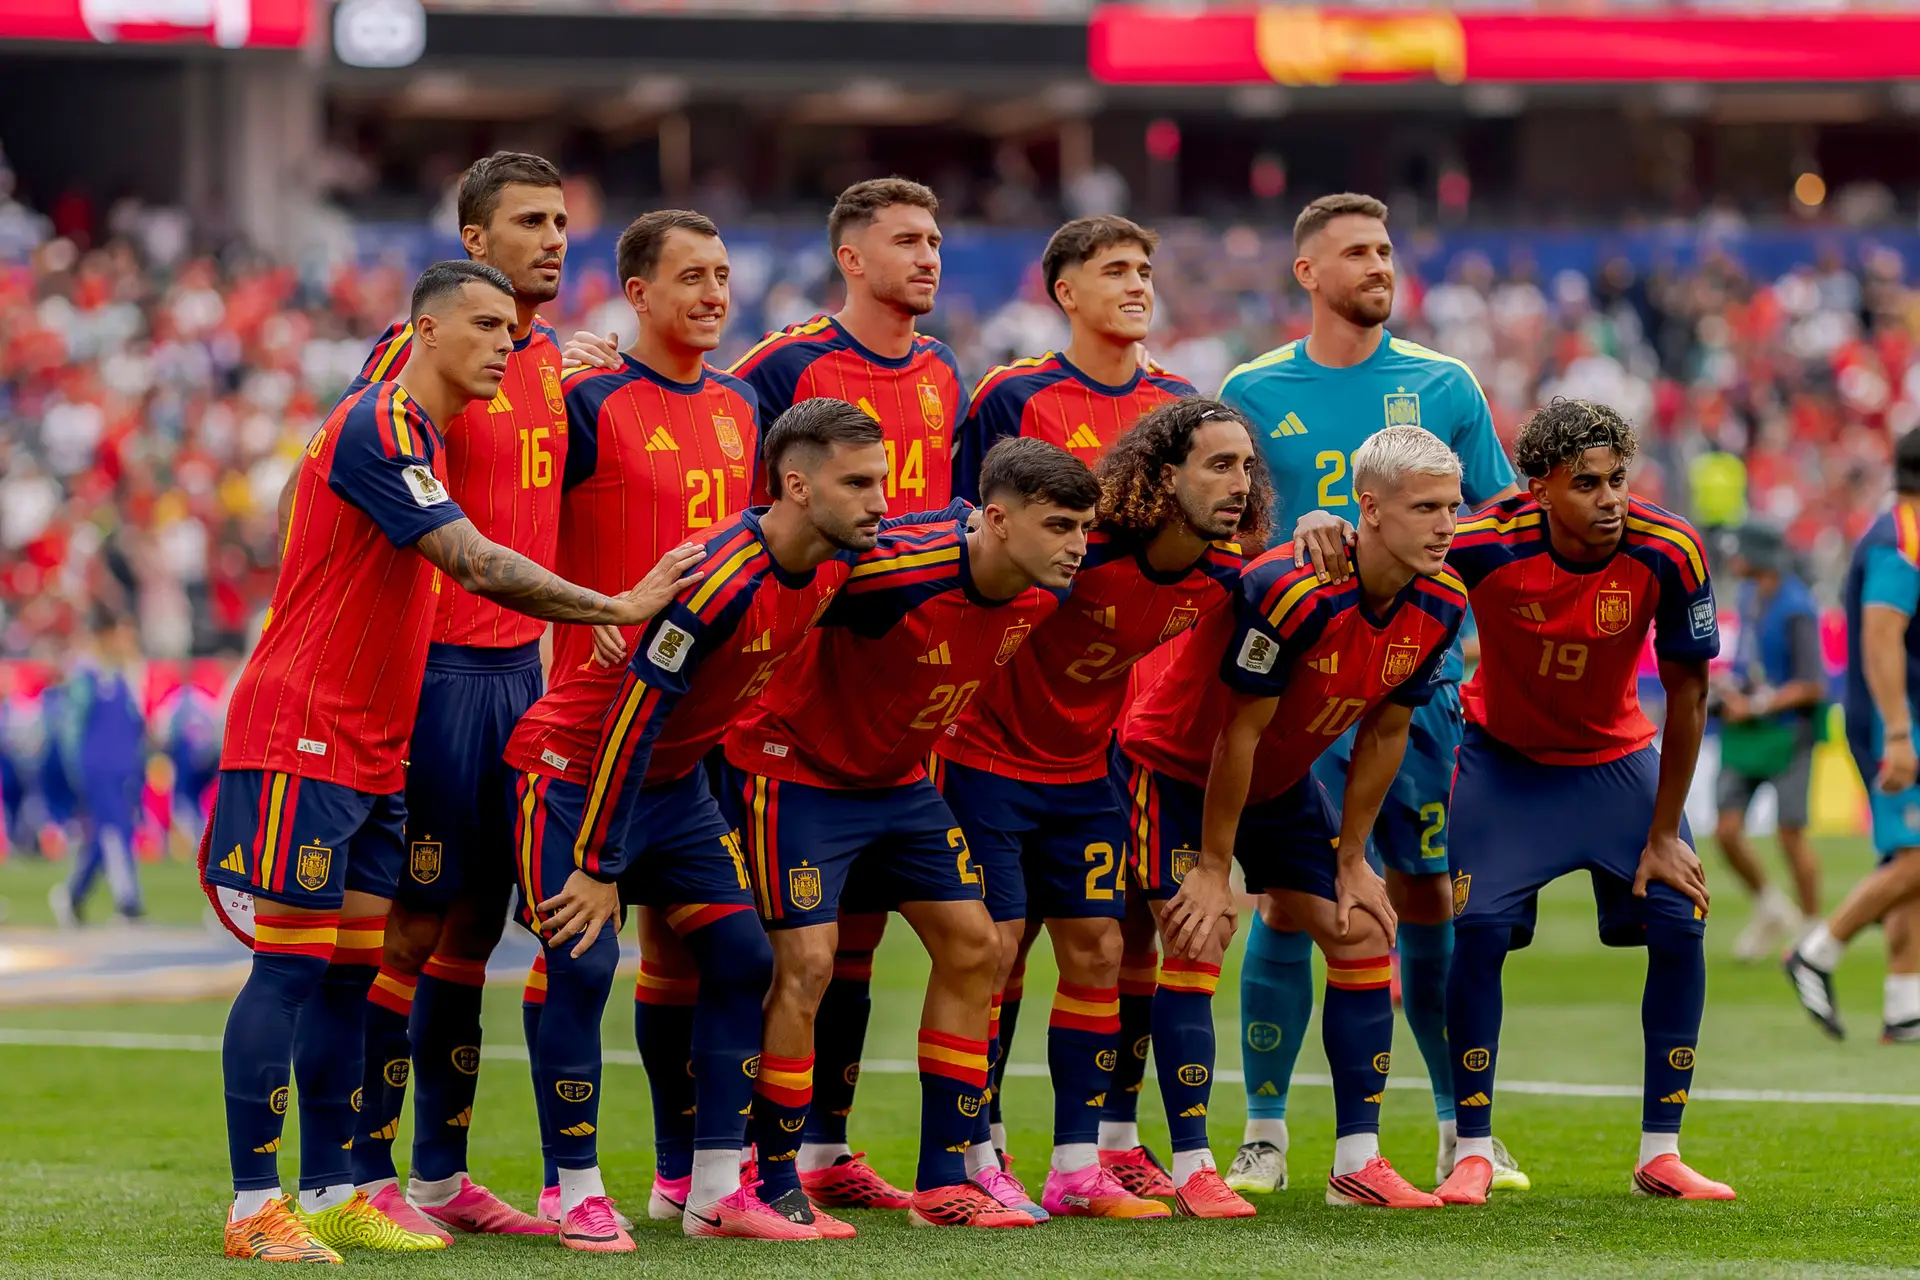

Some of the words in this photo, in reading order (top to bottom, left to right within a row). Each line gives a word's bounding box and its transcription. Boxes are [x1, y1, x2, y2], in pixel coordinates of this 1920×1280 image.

[519, 427, 552, 489] 16
[883, 439, 926, 499] 14
[1316, 450, 1360, 507] 2
[686, 468, 726, 528] 21
[733, 652, 787, 702] 15
[1538, 639, 1589, 681] 19
[909, 680, 980, 729] 20
[1305, 696, 1367, 736] 10
